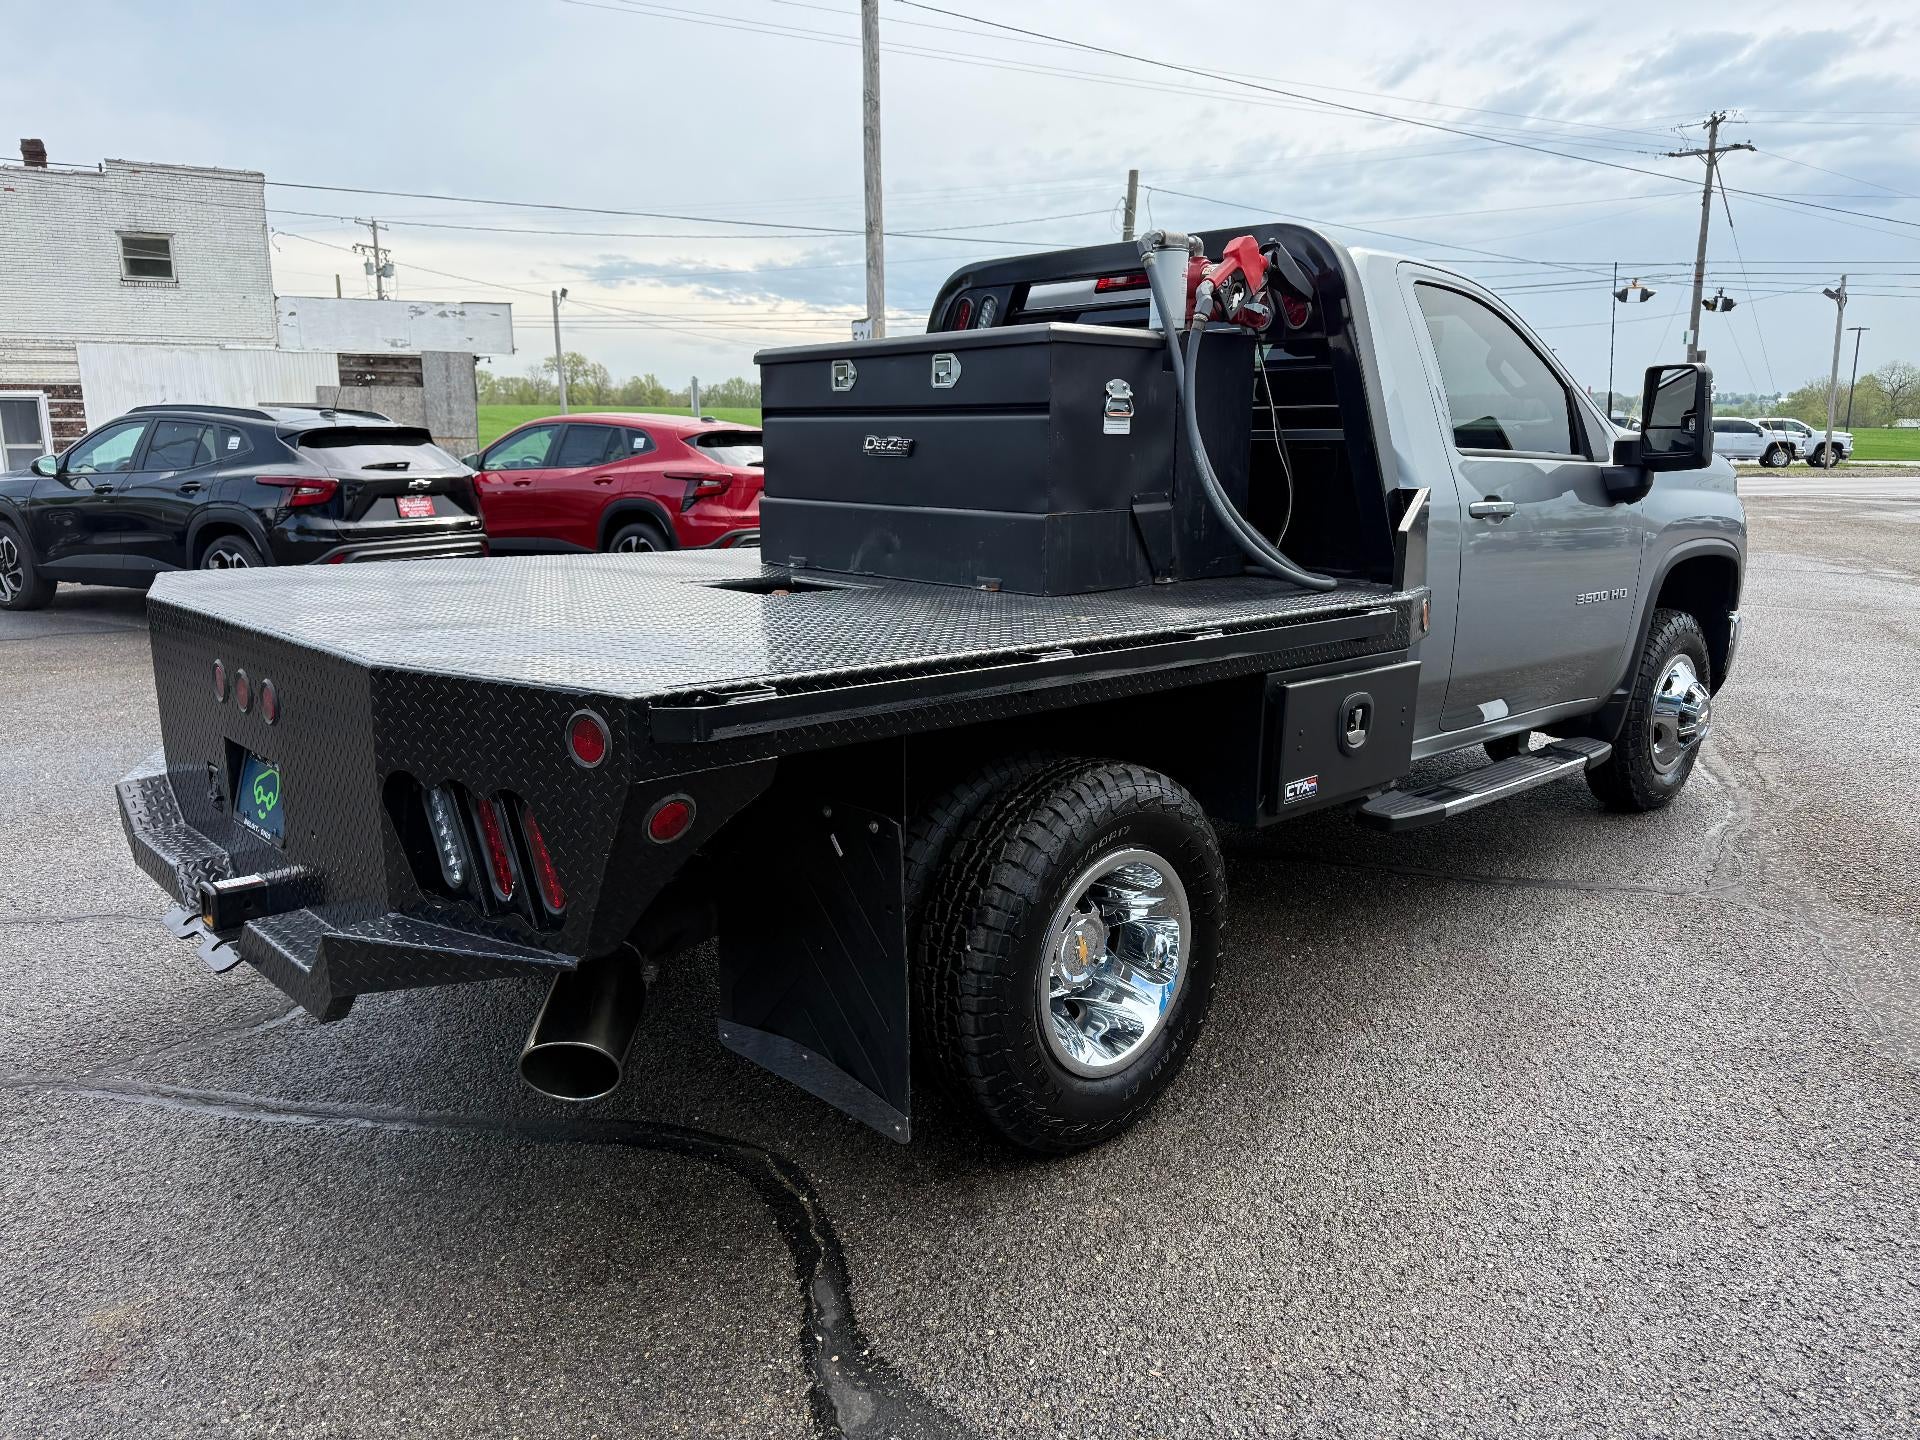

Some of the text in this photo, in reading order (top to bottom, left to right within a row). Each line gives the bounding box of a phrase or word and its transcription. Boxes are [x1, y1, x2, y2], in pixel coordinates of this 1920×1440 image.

[1576, 588, 1628, 605] 3500 HD
[1287, 781, 1310, 798] CTA
